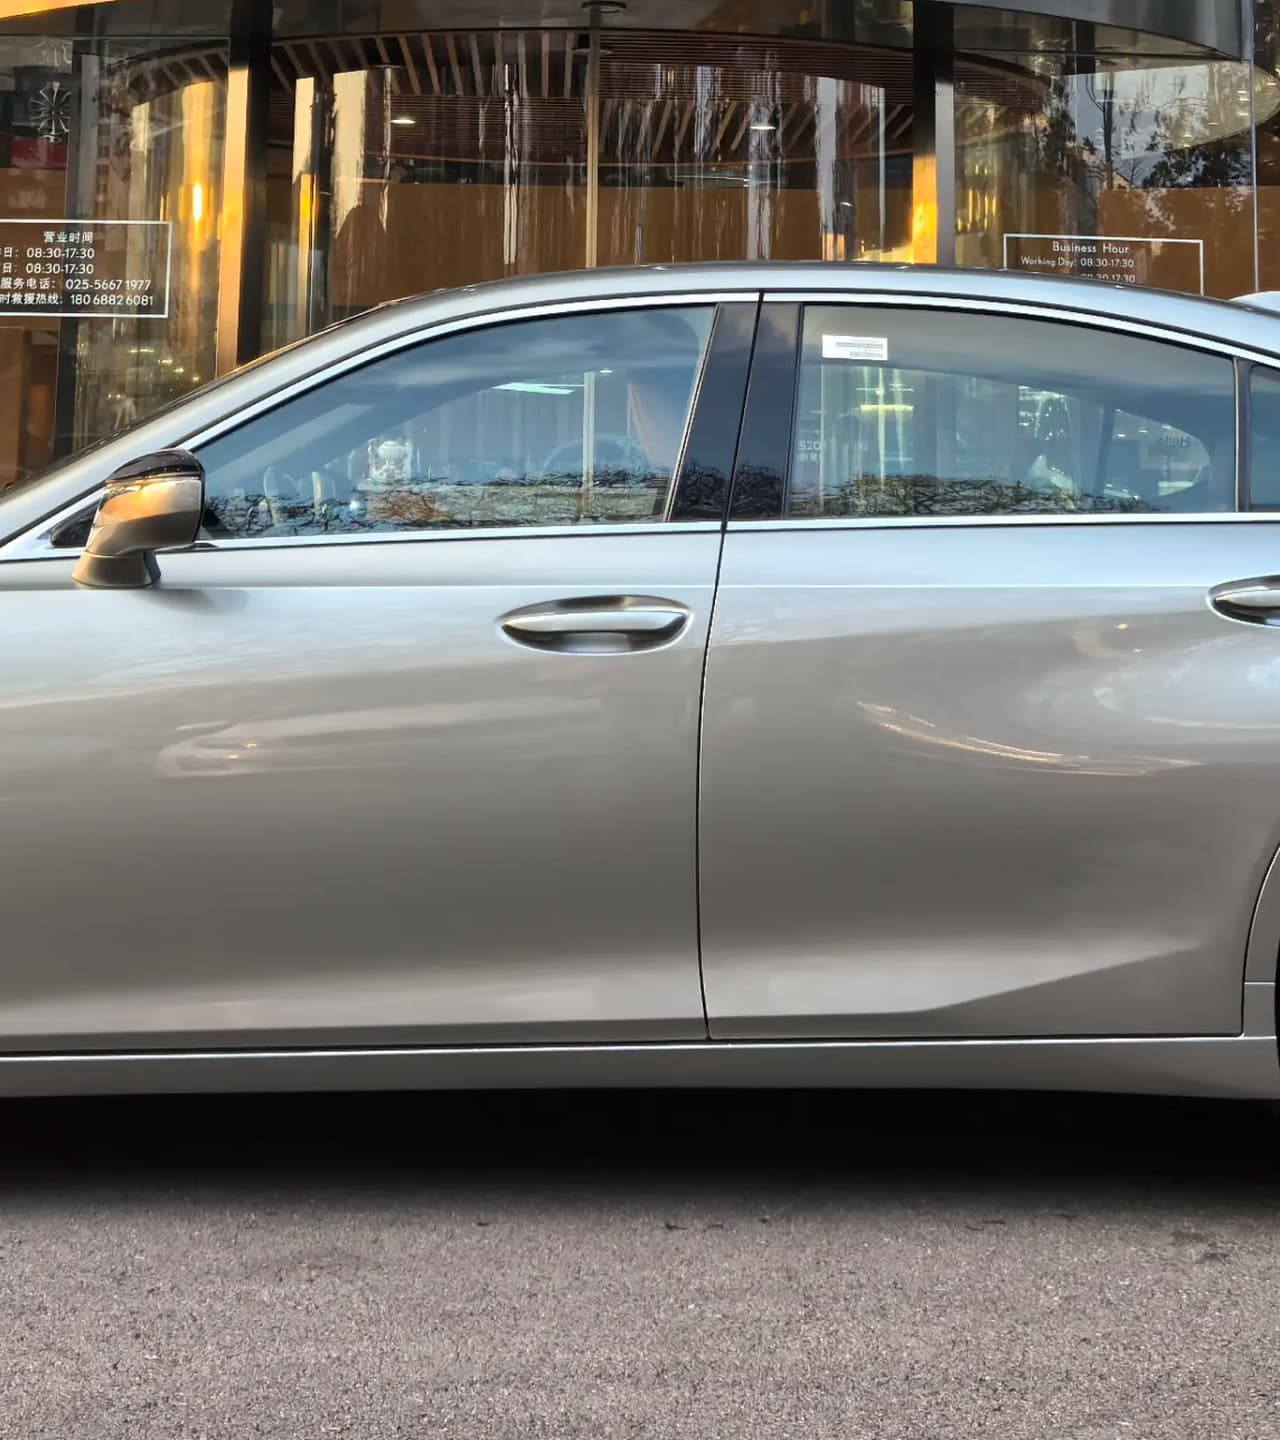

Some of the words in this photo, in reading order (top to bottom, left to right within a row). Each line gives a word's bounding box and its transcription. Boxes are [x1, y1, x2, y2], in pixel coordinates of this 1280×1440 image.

[43, 231, 94, 243] 营业时间
[26, 247, 95, 259] 08:30-17:30
[1052, 241, 1097, 253] Business
[1102, 242, 1130, 254] Hour
[1021, 256, 1056, 267] Working
[1058, 257, 1077, 268] Day:
[1080, 258, 1135, 269] 08:30-17:30
[25, 263, 94, 275] 08:30-17:30
[65, 279, 122, 290] 025-5667
[125, 279, 152, 291] 1977
[70, 294, 91, 305] 180
[93, 294, 124, 306] 6882
[125, 295, 154, 306] 6081
